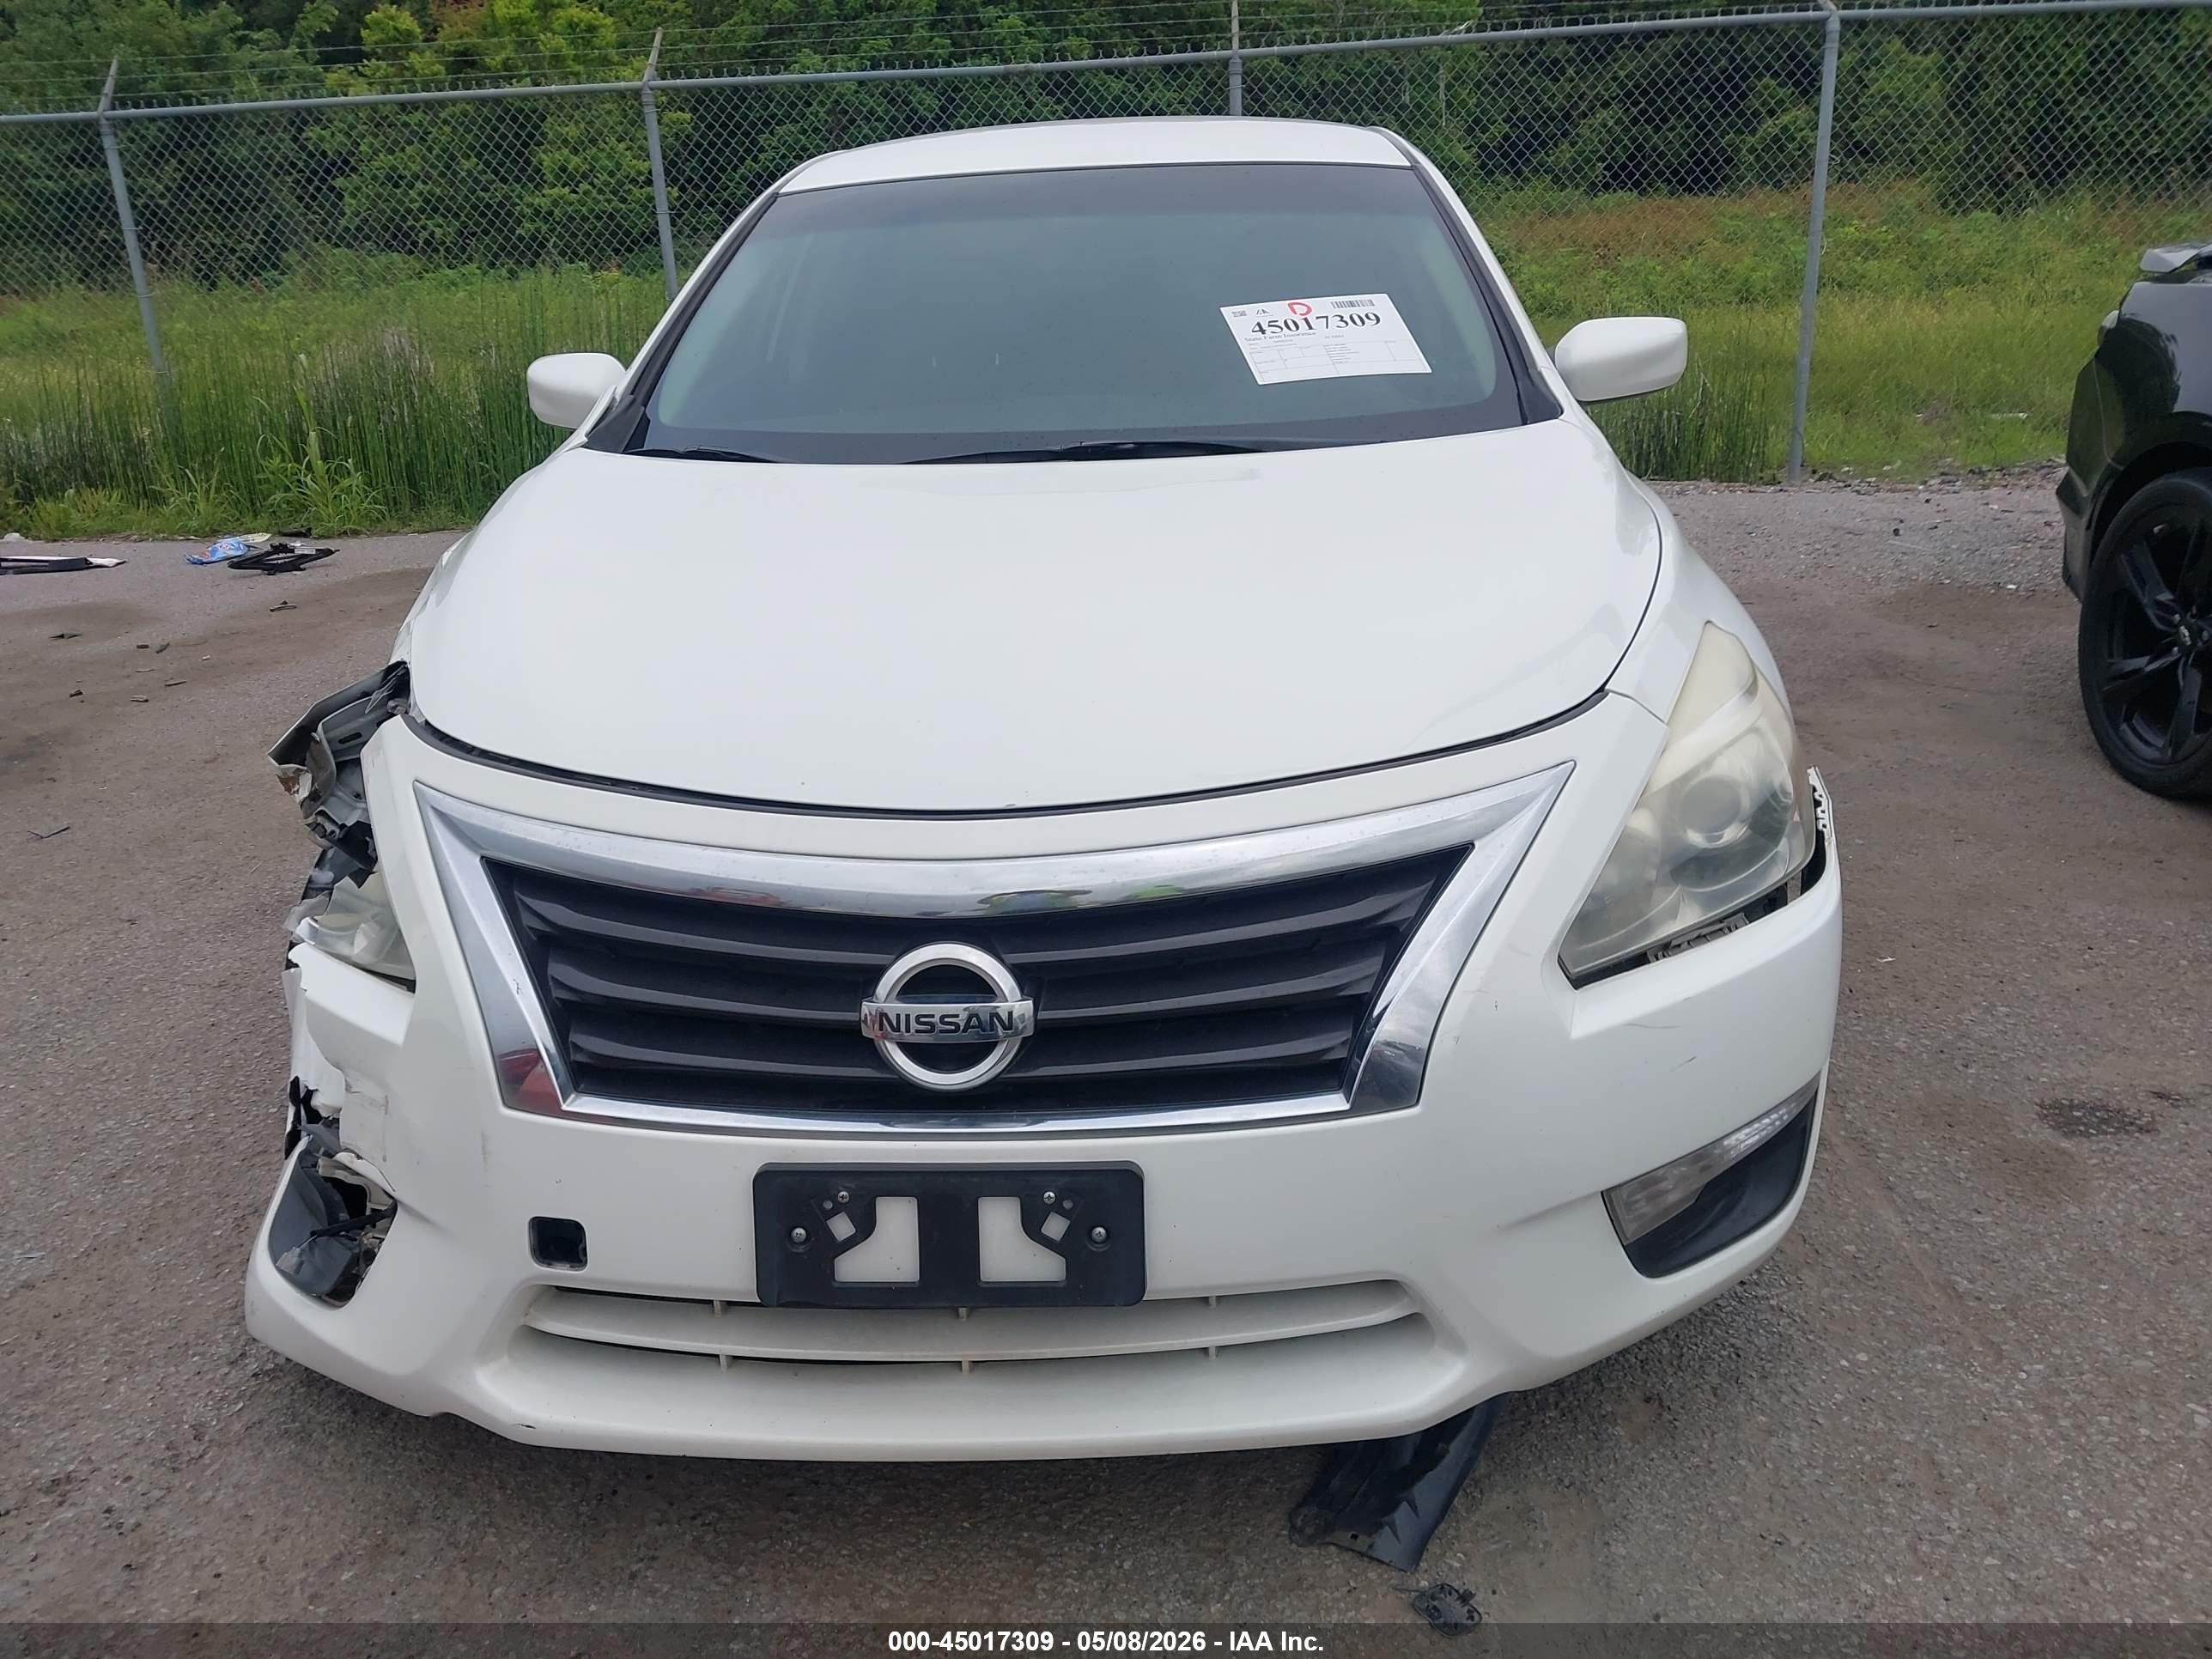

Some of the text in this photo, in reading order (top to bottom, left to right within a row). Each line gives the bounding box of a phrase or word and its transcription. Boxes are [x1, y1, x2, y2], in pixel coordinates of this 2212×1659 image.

[1287, 301, 1313, 317] D
[1251, 312, 1381, 335] 45017309
[878, 1009, 1014, 1035] NISSAN
